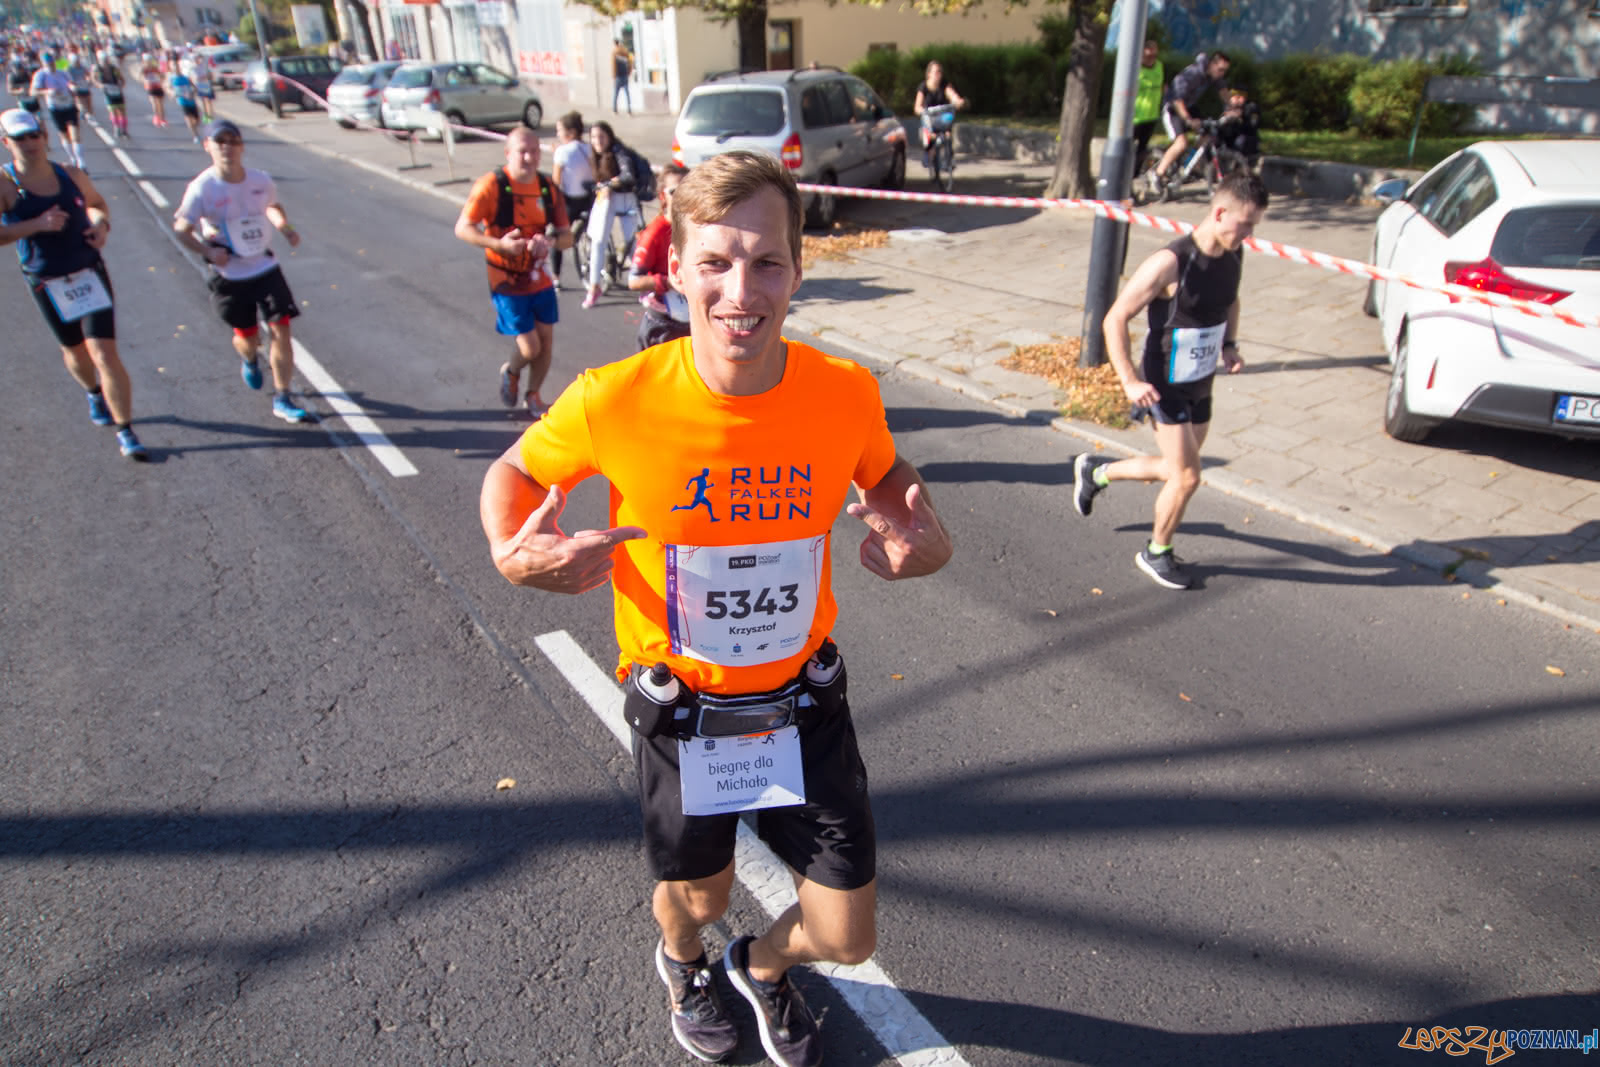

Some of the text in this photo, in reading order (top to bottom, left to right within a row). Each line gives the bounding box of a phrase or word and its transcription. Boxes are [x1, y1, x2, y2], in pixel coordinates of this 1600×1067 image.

[730, 464, 811, 485] RUN
[730, 486, 812, 499] FALKEN
[730, 502, 810, 521] RUN
[705, 583, 799, 620] 5343
[728, 621, 777, 636] Krzysztof
[708, 755, 773, 776] biegnę dla
[717, 775, 768, 793] Michała
